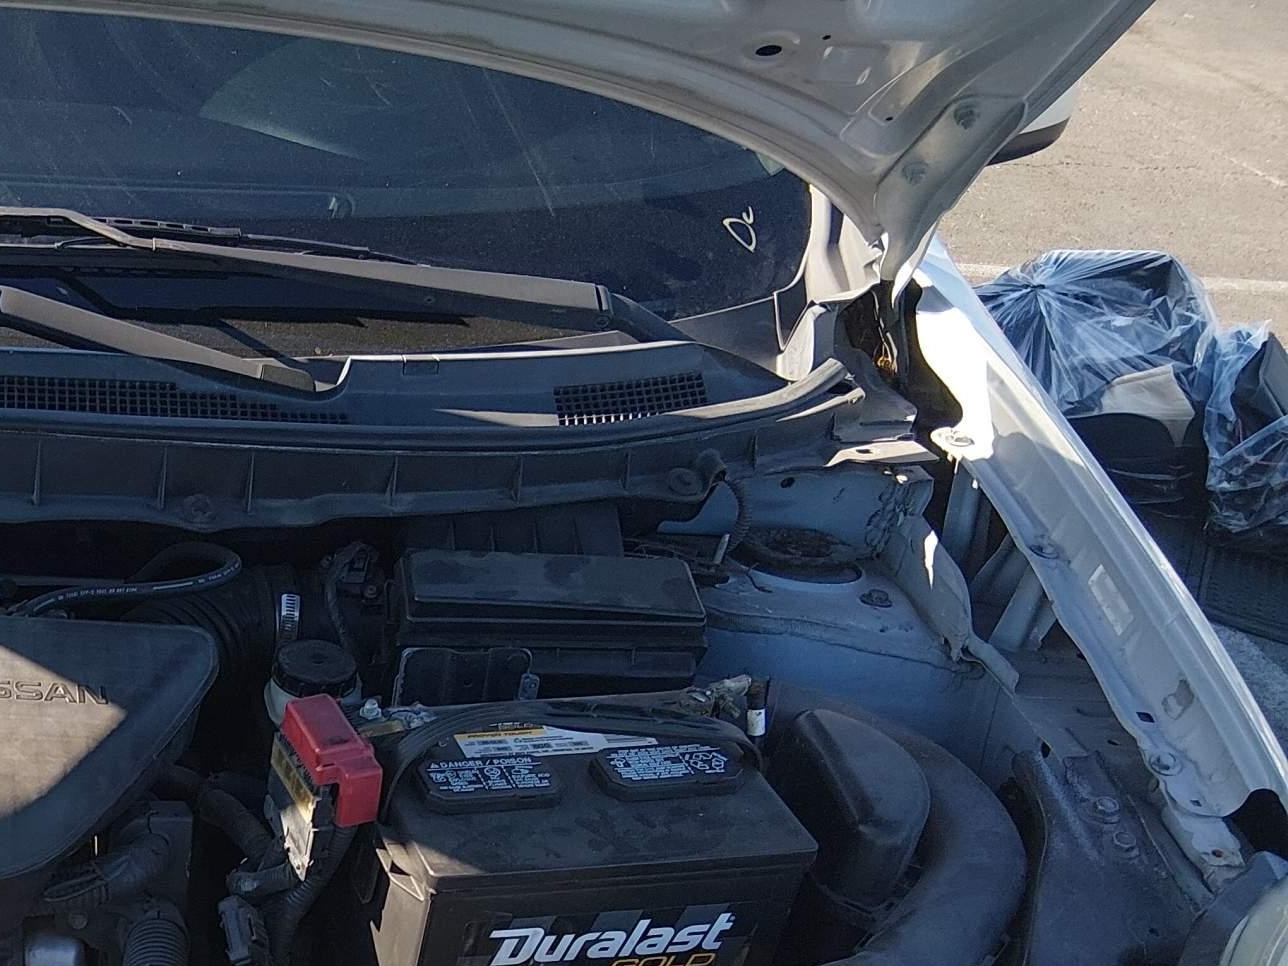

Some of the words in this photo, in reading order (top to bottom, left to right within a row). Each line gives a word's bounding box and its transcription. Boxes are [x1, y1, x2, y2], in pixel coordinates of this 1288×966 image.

[439, 760, 483, 768] DANGER
[492, 757, 532, 765] POISON
[489, 912, 734, 966] Duralast
